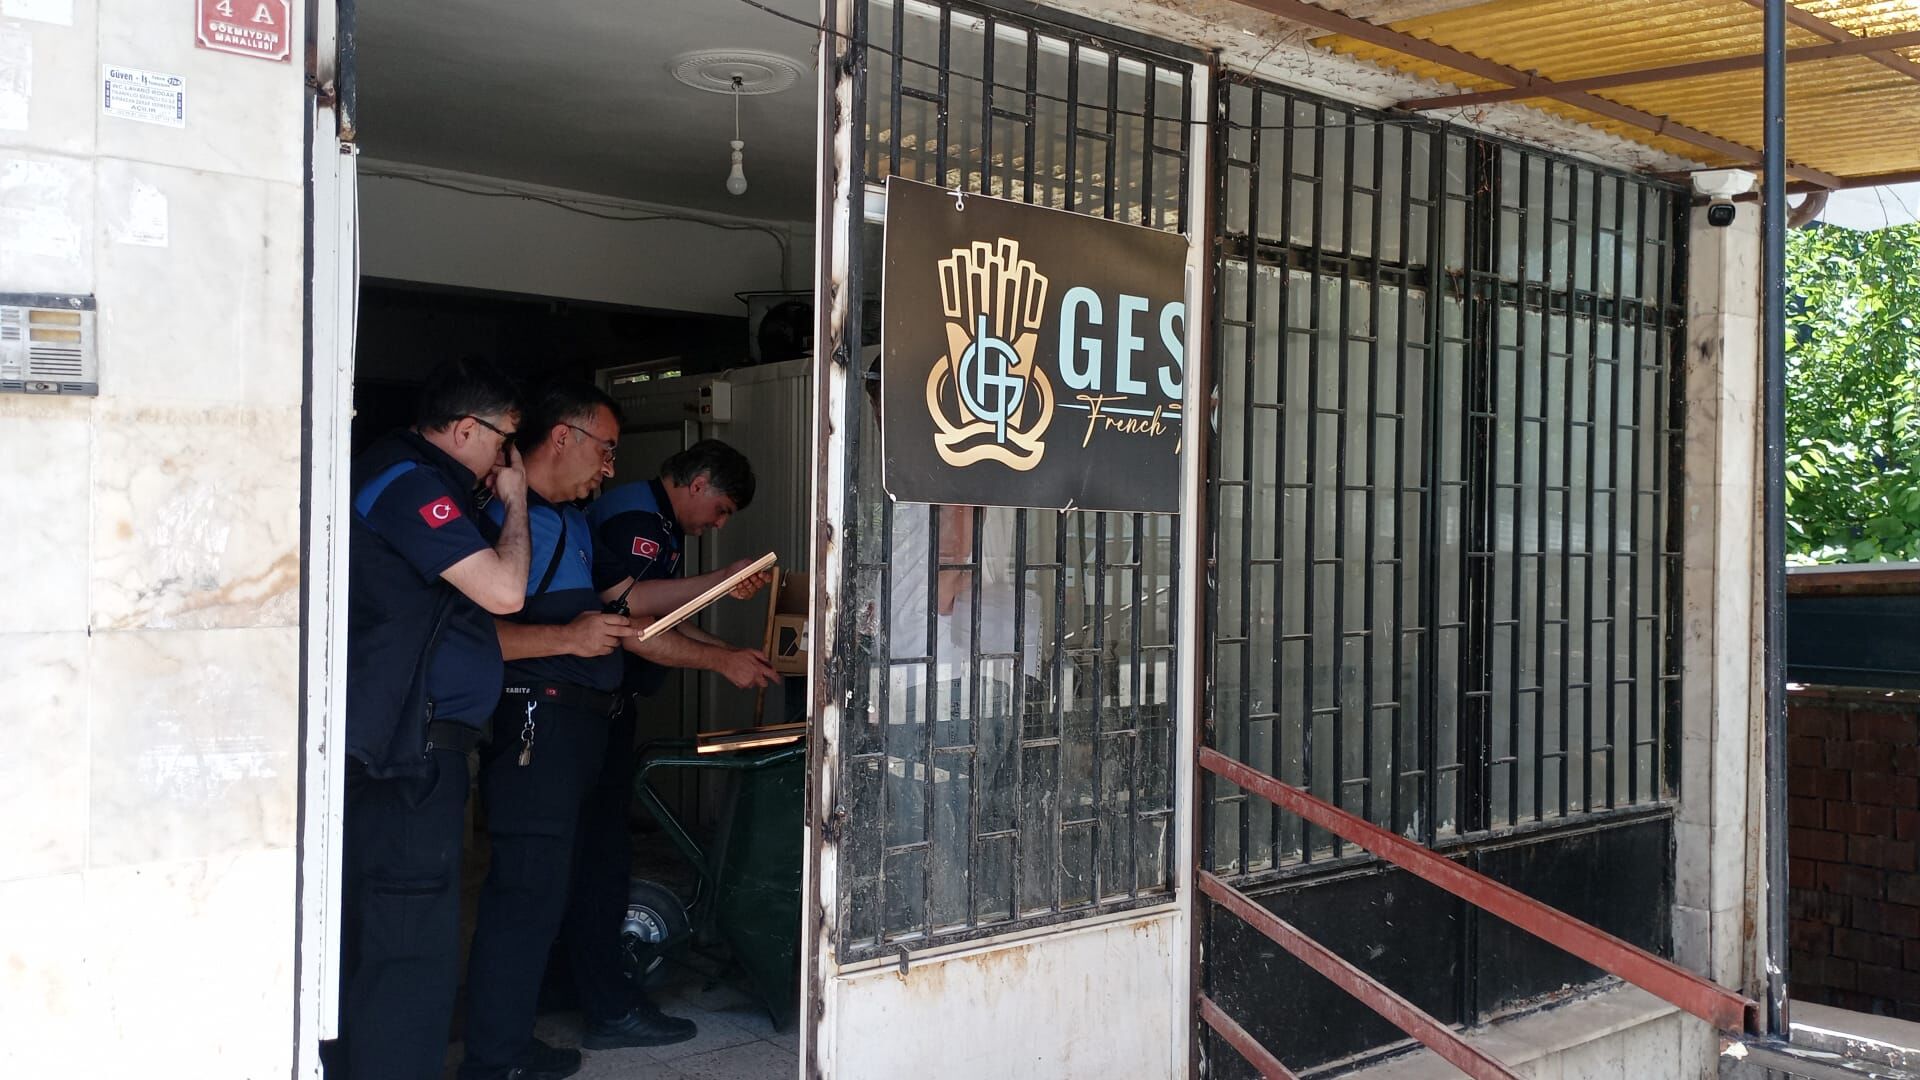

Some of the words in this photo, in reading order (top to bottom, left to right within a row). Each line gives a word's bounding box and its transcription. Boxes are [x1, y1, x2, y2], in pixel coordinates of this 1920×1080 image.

[216, 0, 233, 17] 4
[250, 3, 274, 25] A
[110, 69, 133, 81] Güven
[1076, 394, 1167, 448] French
